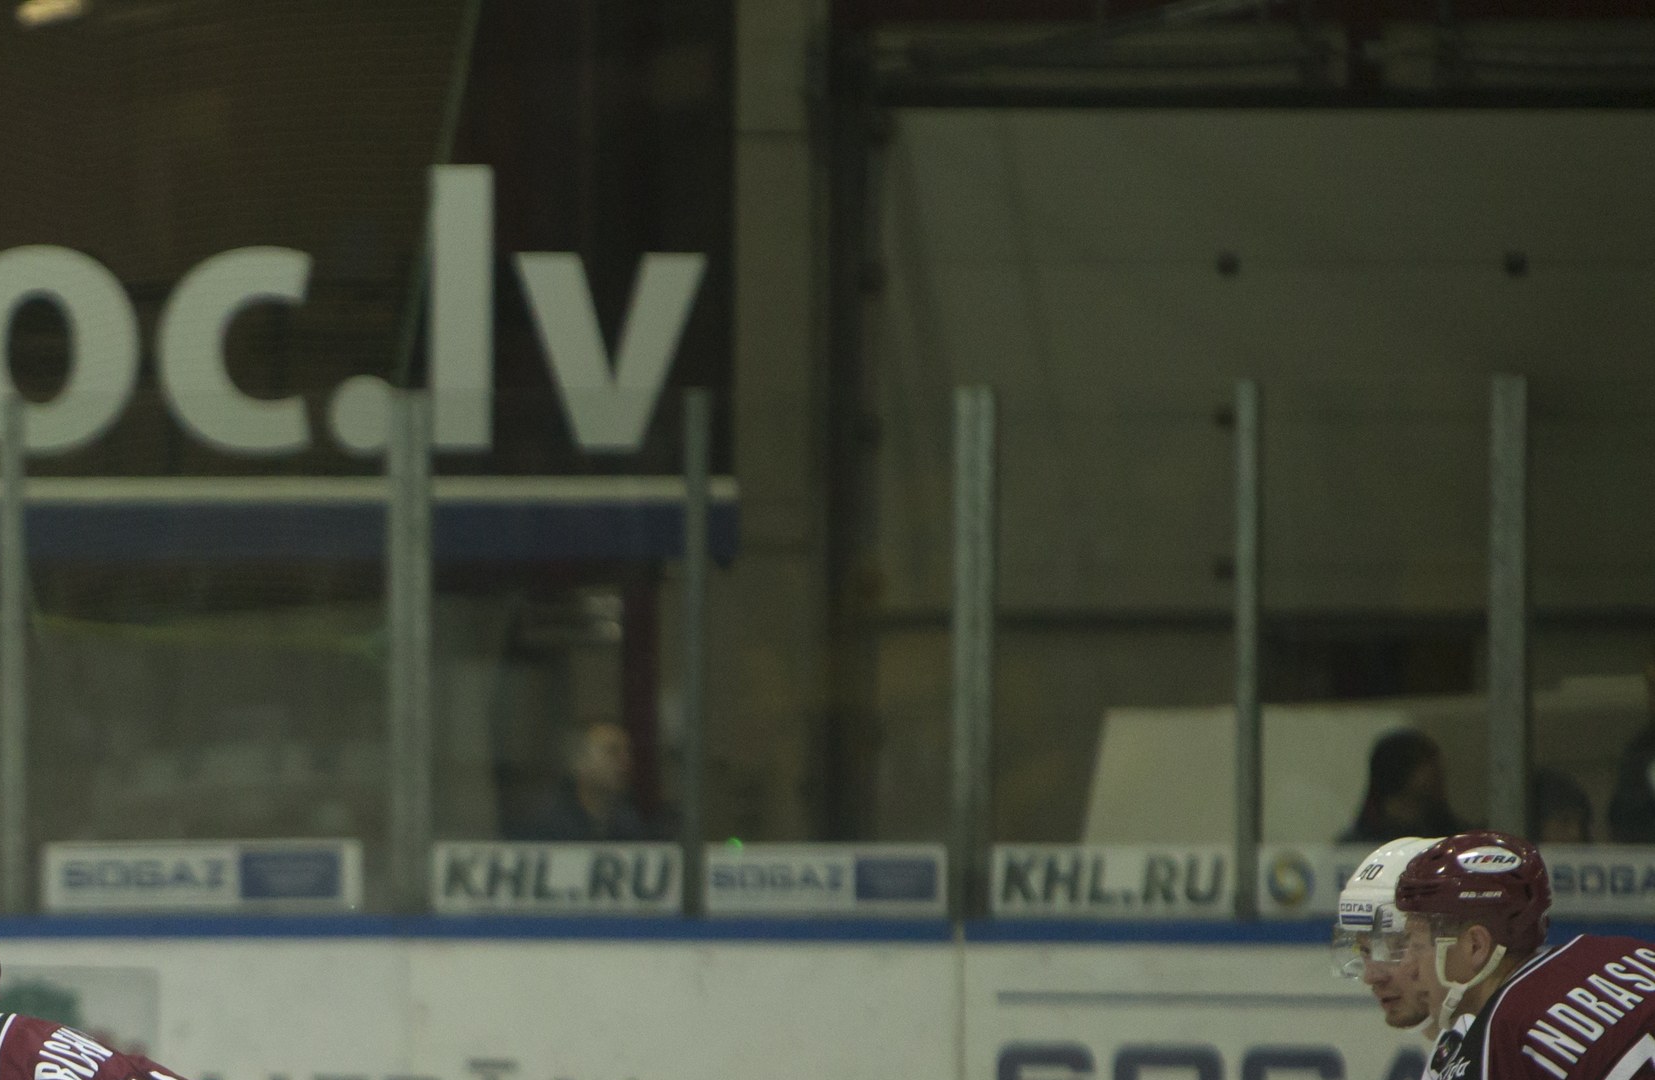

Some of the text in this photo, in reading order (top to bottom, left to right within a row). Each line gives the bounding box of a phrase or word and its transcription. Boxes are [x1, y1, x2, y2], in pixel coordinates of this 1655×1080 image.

[61, 857, 225, 889] SOGAZ
[445, 852, 671, 900] KHL.RU
[712, 864, 845, 891] SOGAZ
[998, 854, 1227, 901] KHL.RU
